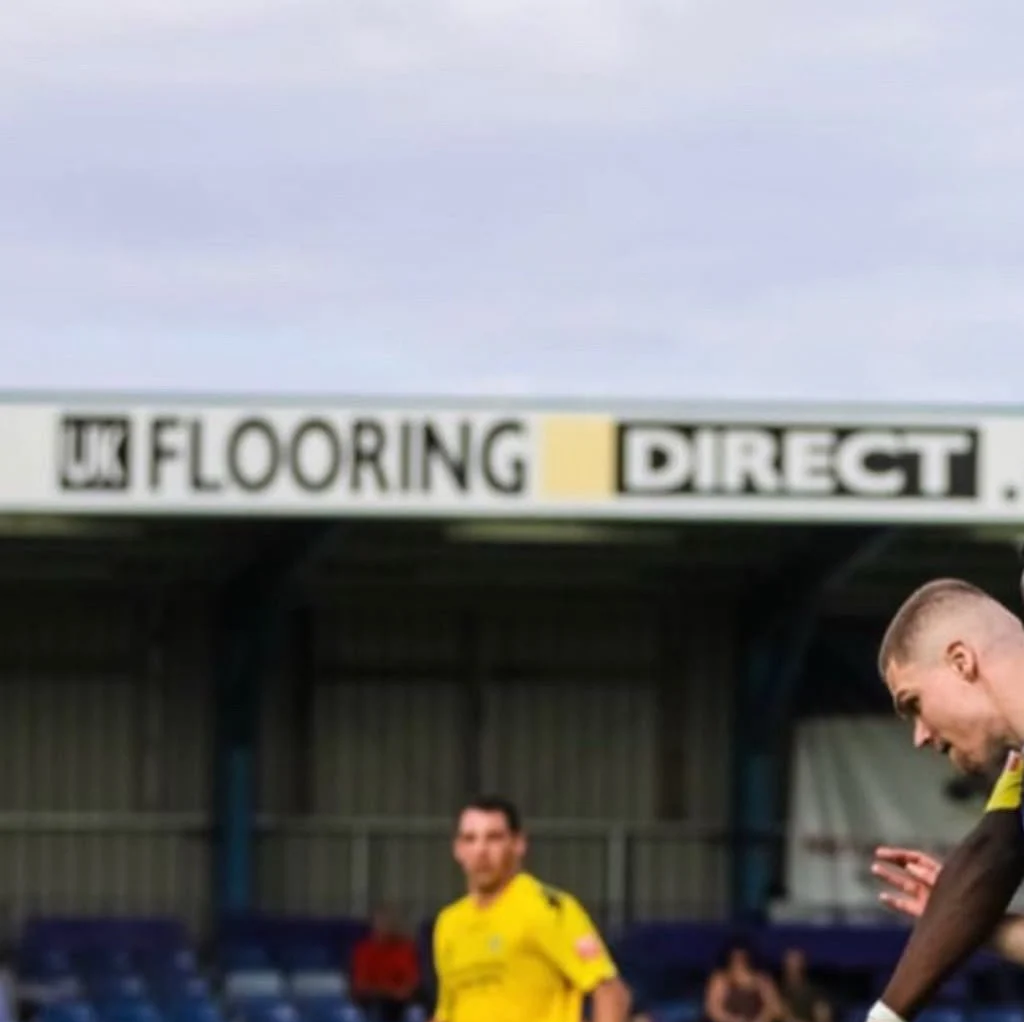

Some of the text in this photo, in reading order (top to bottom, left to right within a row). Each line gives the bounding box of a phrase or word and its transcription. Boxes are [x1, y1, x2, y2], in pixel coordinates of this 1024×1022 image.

[60, 415, 131, 491] UK
[149, 417, 527, 494] FLOORING
[621, 428, 972, 495] DIRECT
